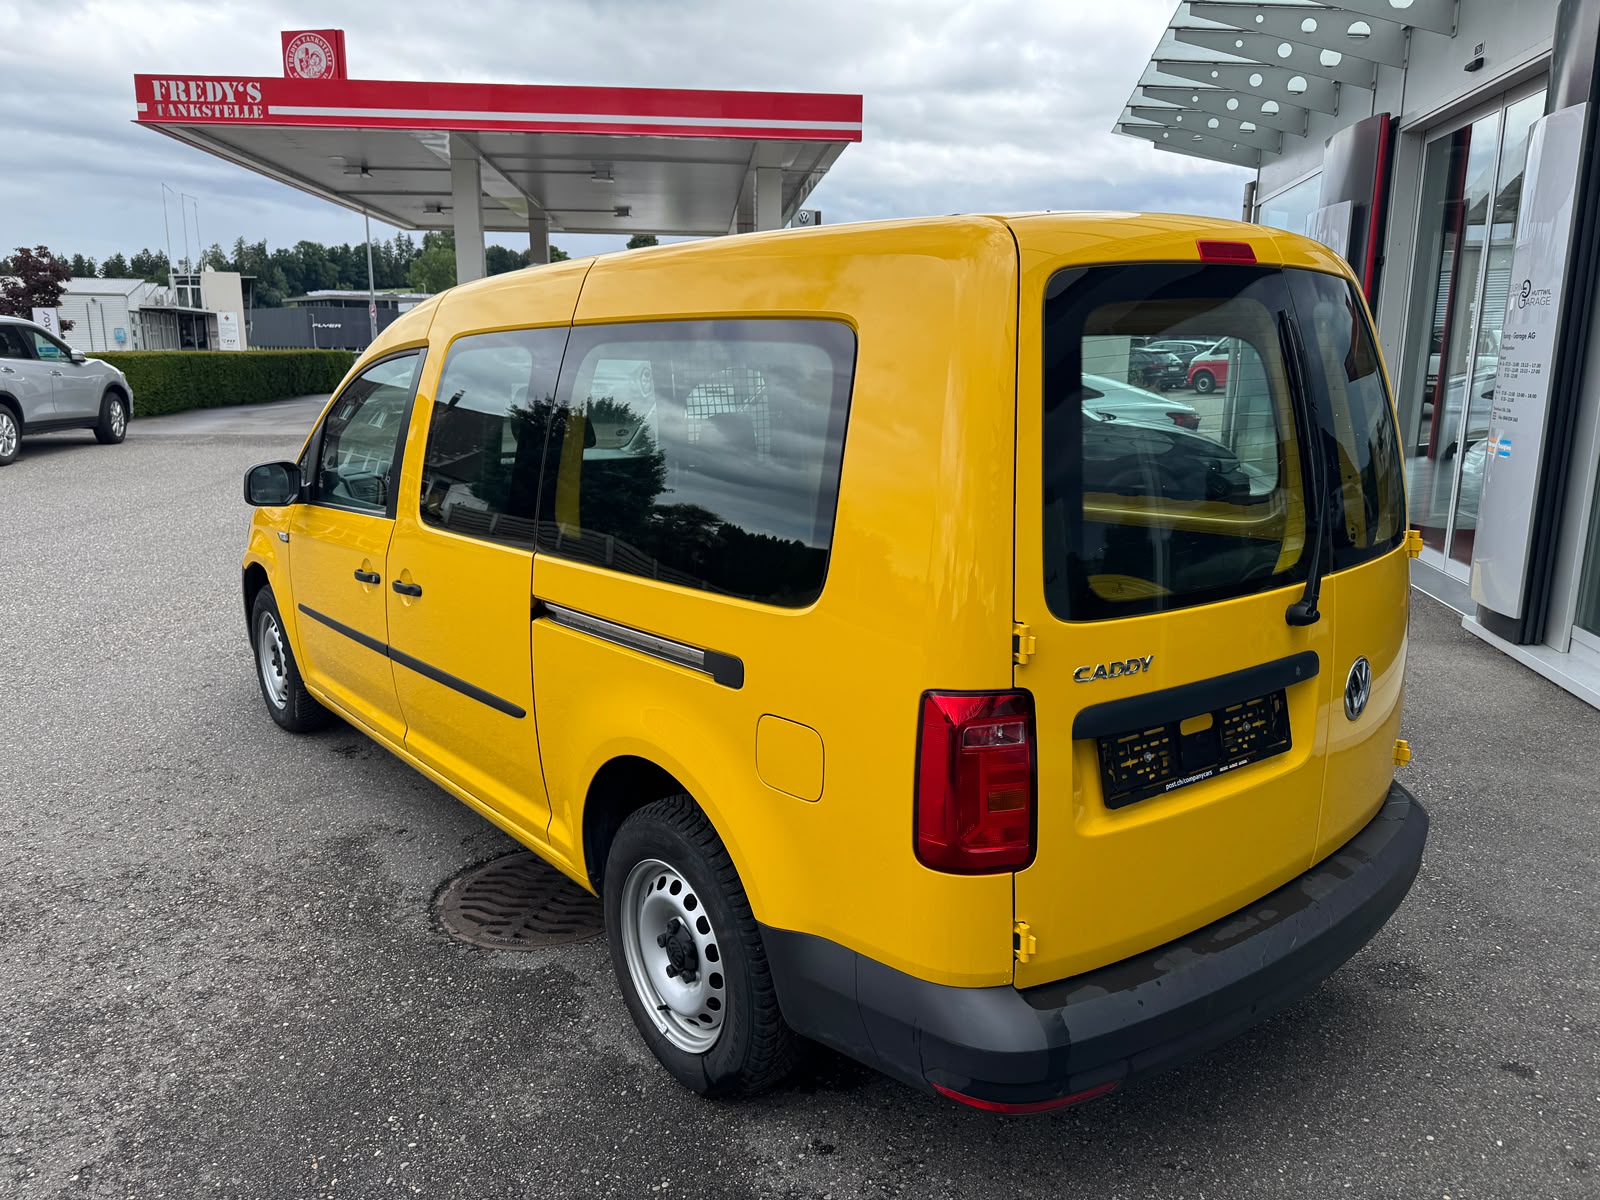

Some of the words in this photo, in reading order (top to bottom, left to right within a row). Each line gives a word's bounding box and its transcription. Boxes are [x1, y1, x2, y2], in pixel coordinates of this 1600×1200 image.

[152, 80, 262, 103] FREDY'S
[155, 104, 264, 118] TANKSTELLE
[1528, 331, 1536, 339] AG
[1073, 655, 1154, 683] CADDY
[1165, 769, 1213, 791] post.ch/companycars
